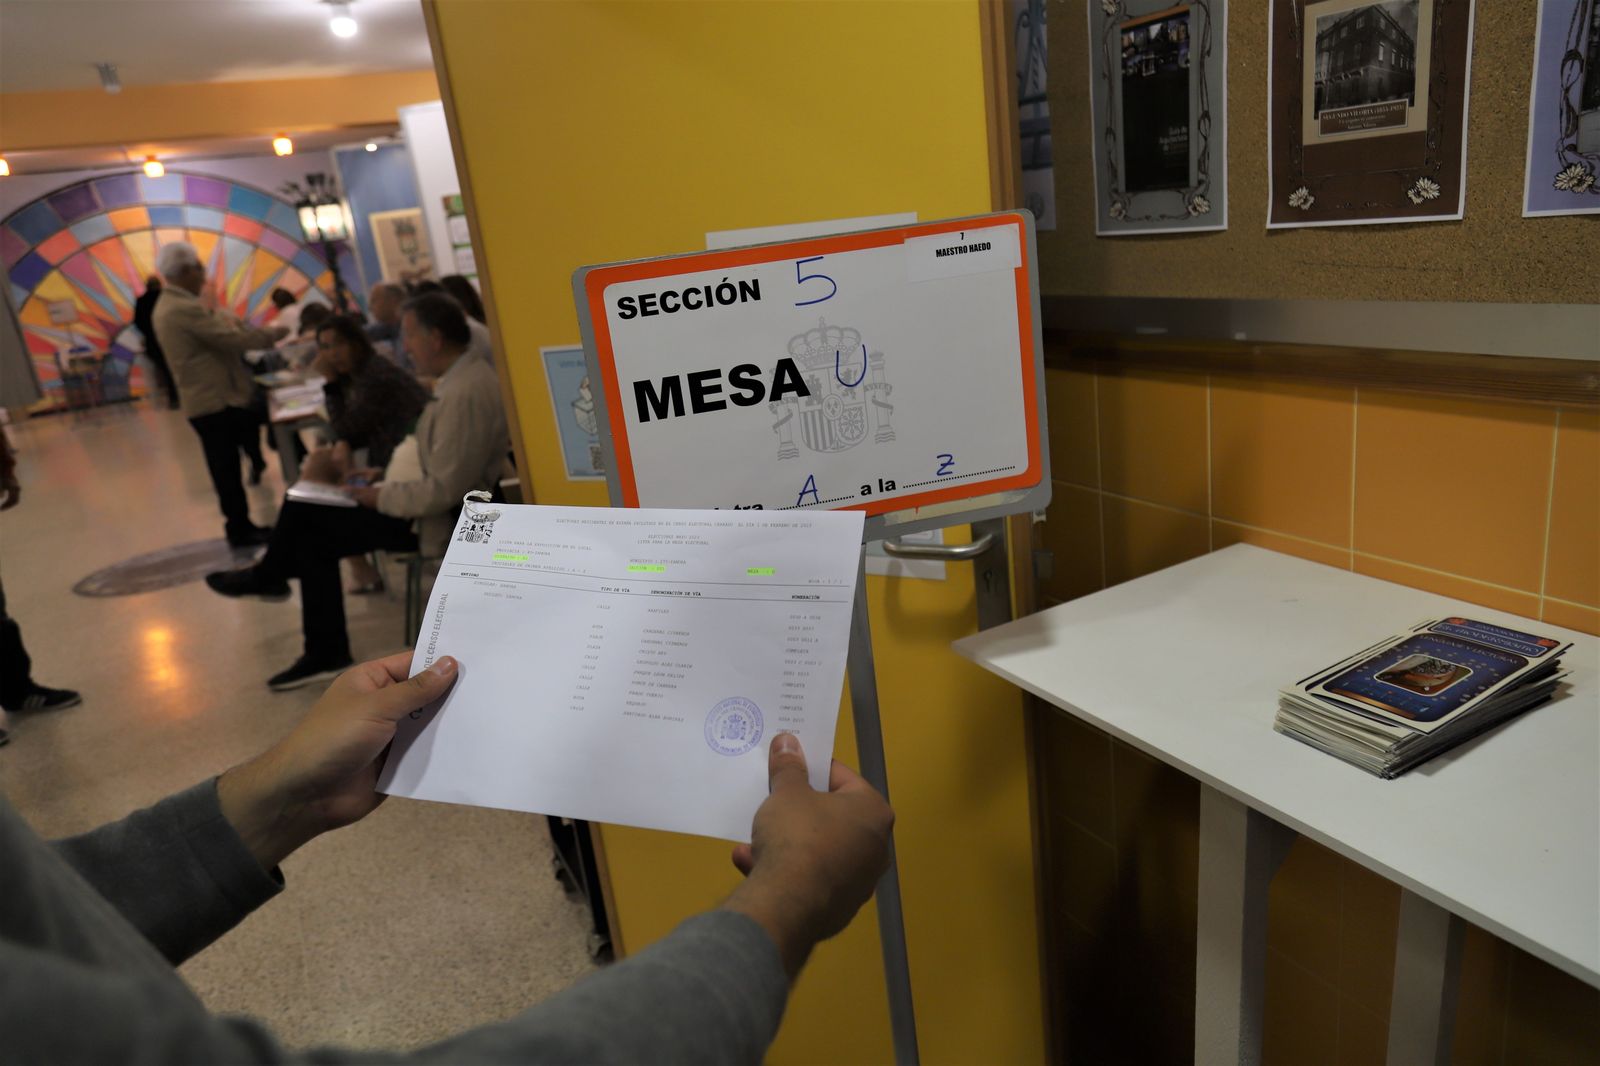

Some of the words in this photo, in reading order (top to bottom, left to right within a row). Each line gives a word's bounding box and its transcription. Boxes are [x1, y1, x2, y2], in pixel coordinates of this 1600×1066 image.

[936, 245, 968, 258] MAESTRO
[969, 242, 991, 253] HAEDO
[960, 232, 965, 240] 7
[617, 277, 761, 320] SECCIÓN
[795, 256, 837, 306] 5
[633, 357, 811, 423] MESA
[836, 344, 868, 389] U
[797, 474, 819, 507] A
[860, 484, 872, 497] a
[878, 478, 897, 494] la
[936, 454, 956, 476] Z
[433, 592, 449, 630] ELECTORAL
[427, 631, 440, 656] CENSO
